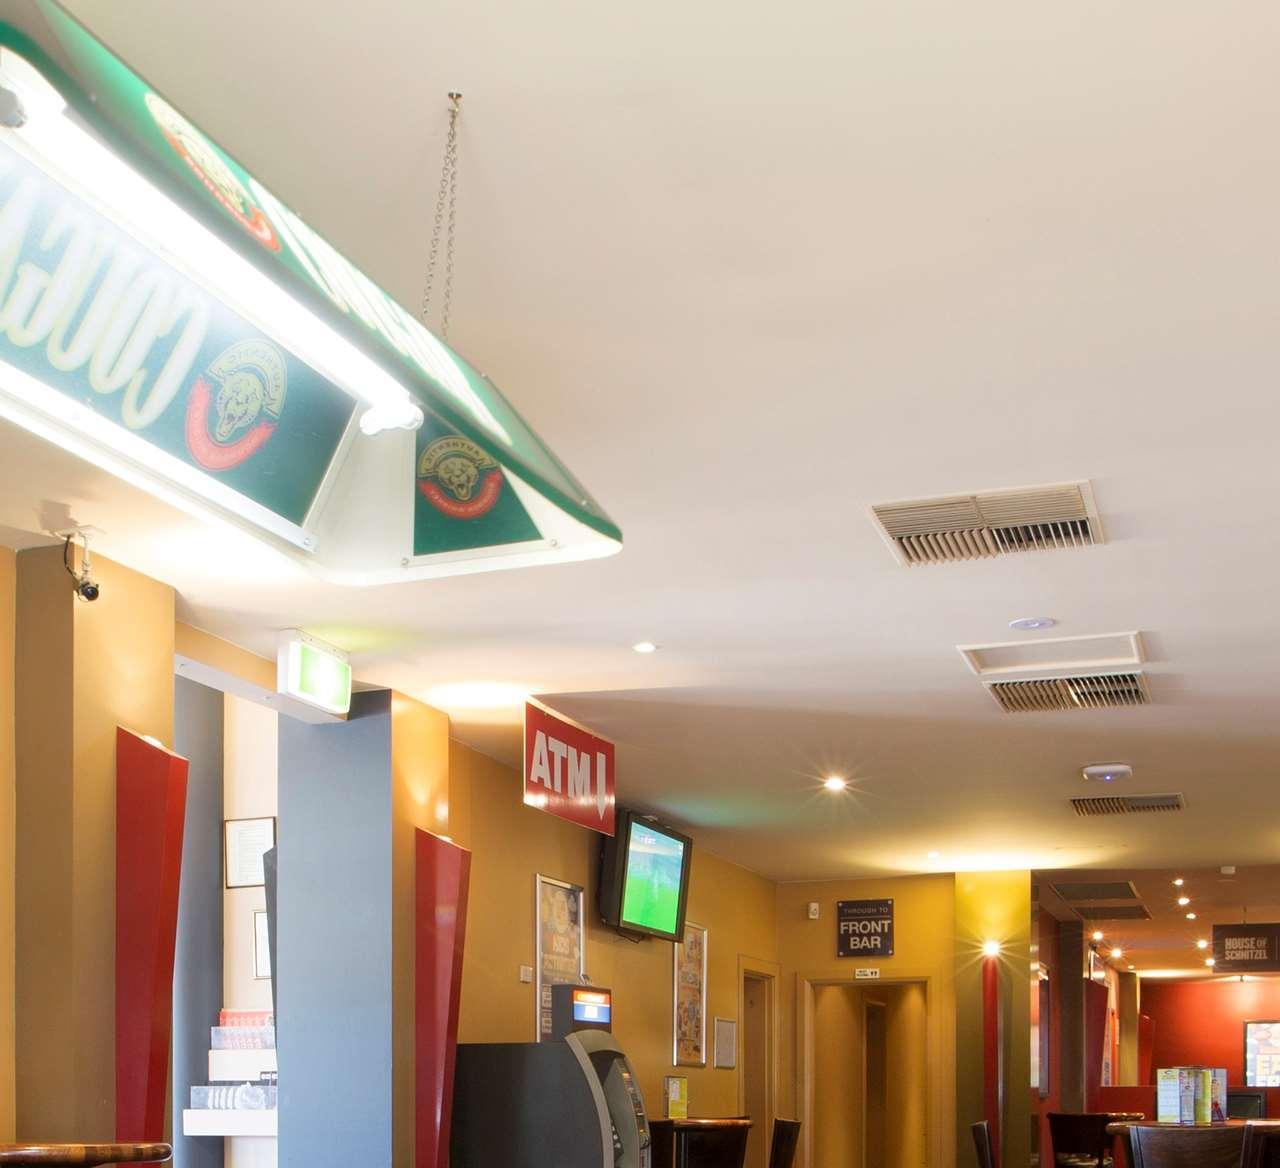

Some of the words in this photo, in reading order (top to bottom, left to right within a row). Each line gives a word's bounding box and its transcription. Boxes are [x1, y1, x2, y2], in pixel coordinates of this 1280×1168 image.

[530, 730, 591, 803] ATM
[840, 920, 892, 934] FRONT
[850, 936, 881, 949] BAR
[1224, 937, 1256, 950] HOUSE
[1224, 950, 1269, 961] SCHNITZEL
